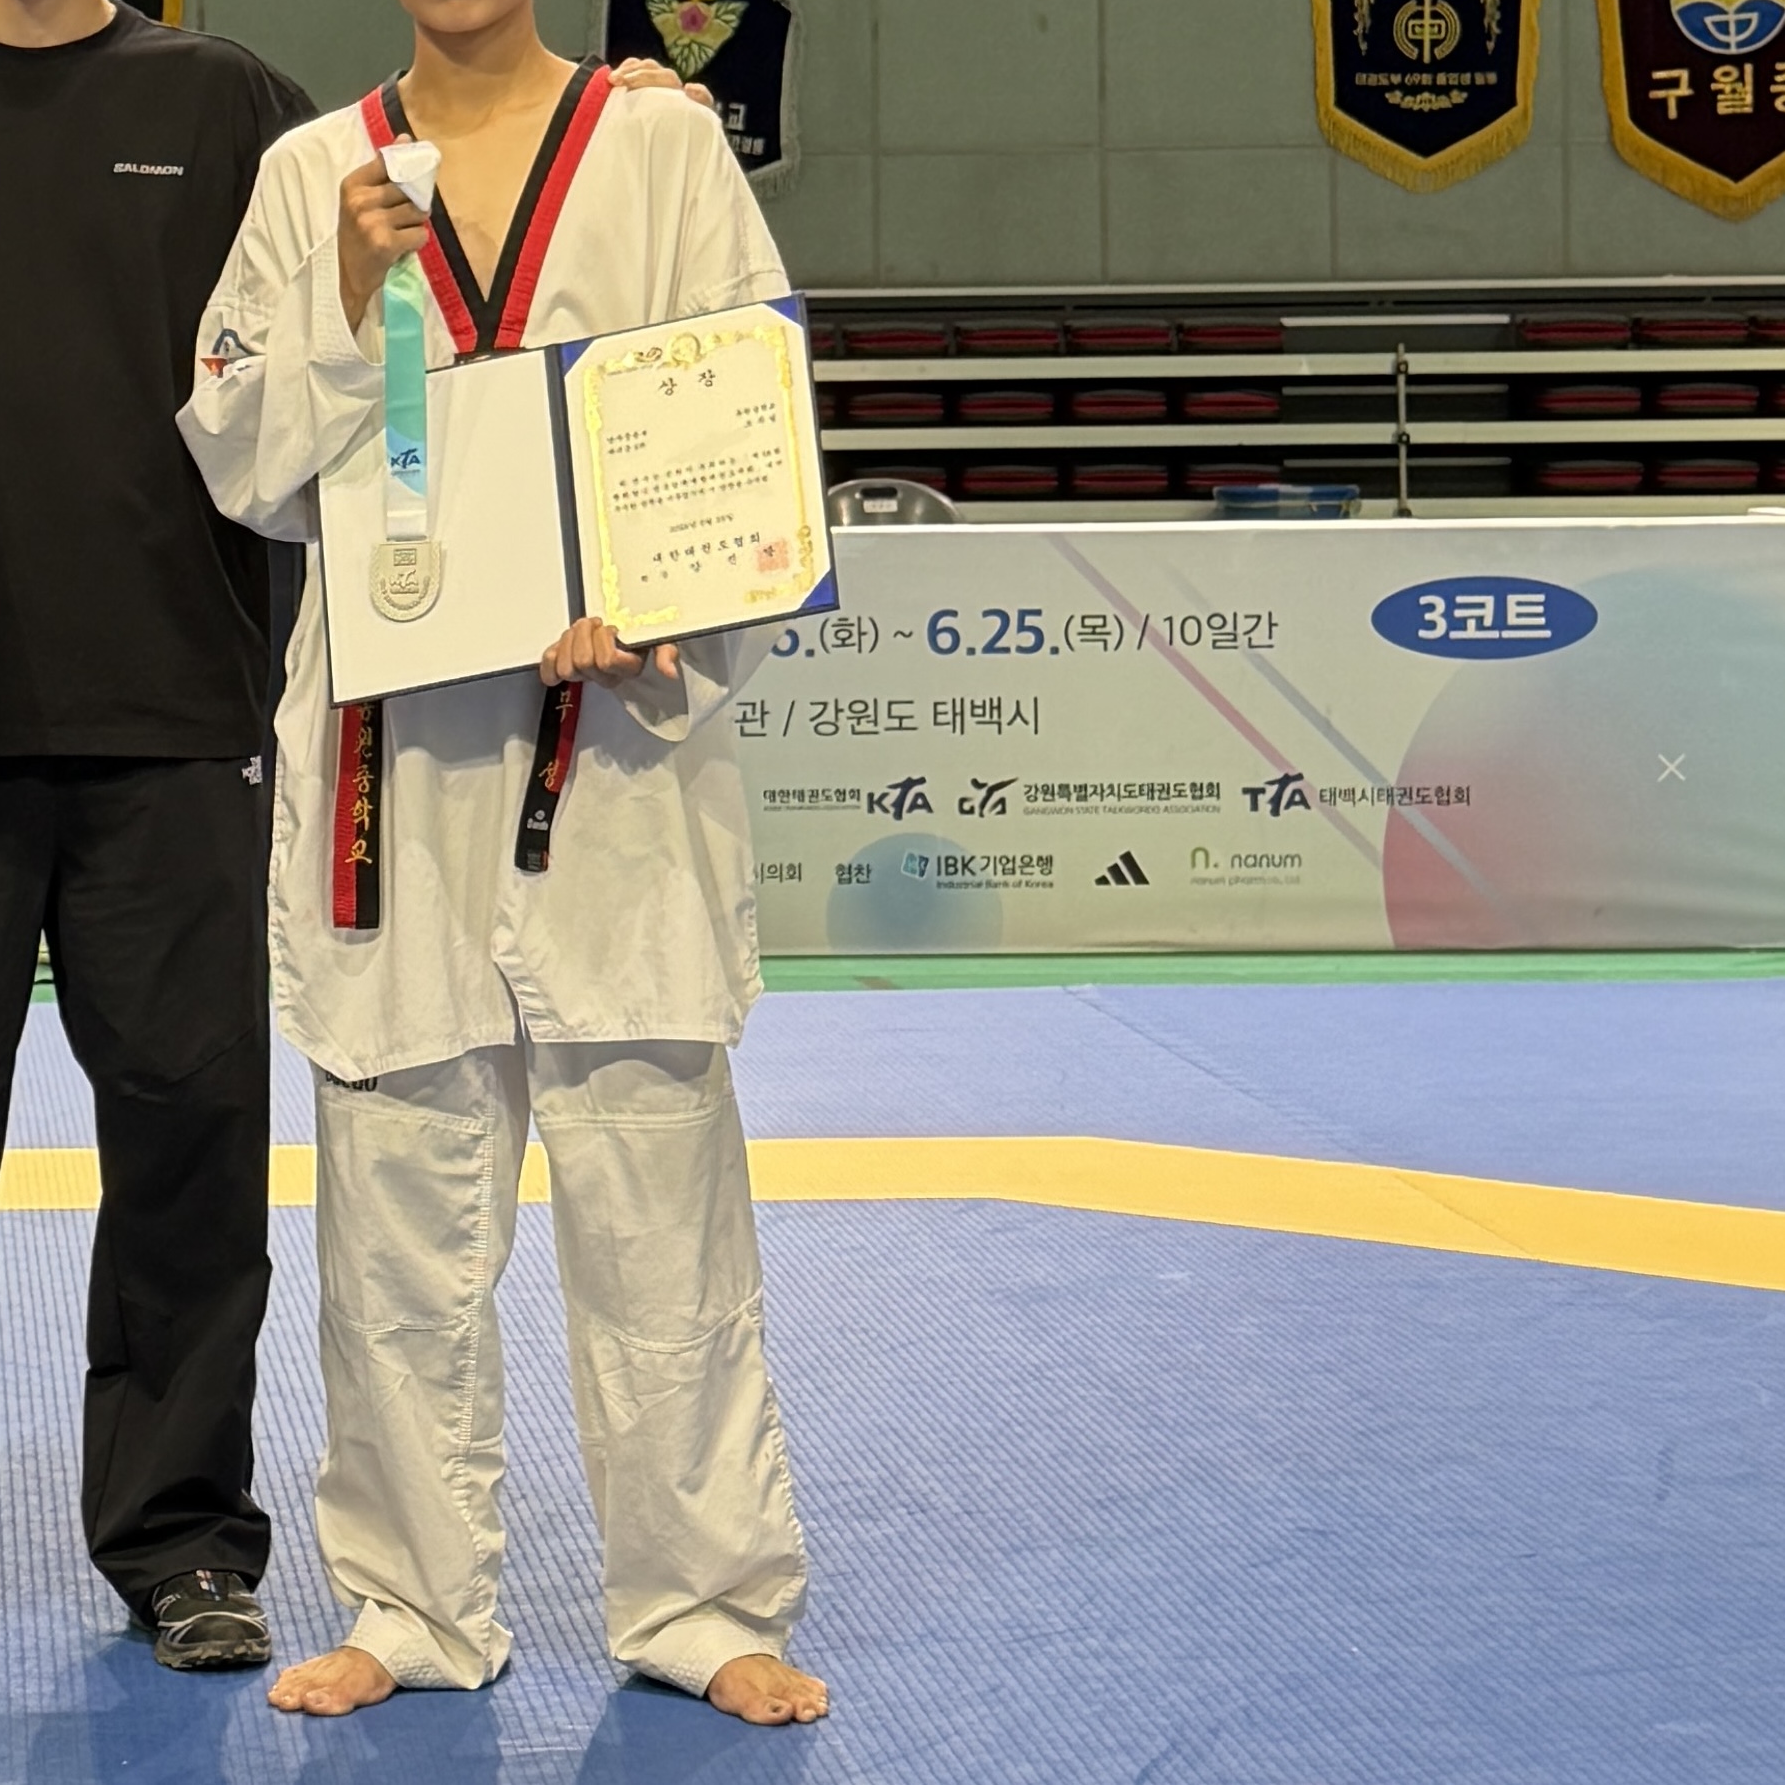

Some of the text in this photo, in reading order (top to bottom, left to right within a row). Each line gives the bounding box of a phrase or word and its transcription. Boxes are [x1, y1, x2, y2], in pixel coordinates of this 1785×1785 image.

[113, 163, 184, 177] SALOMON
[1163, 611, 1280, 651] 10일간
[1417, 593, 1552, 640] 3코트
[808, 697, 919, 736] 강원도
[931, 695, 1042, 737] 태백시
[762, 787, 862, 805] 대한태권도협회
[1023, 781, 1222, 805] 강원특별자치도태권도협회
[1319, 784, 1471, 808] 태백시태권도협회
[835, 863, 873, 886] 협찬
[1230, 851, 1303, 870] nanum
